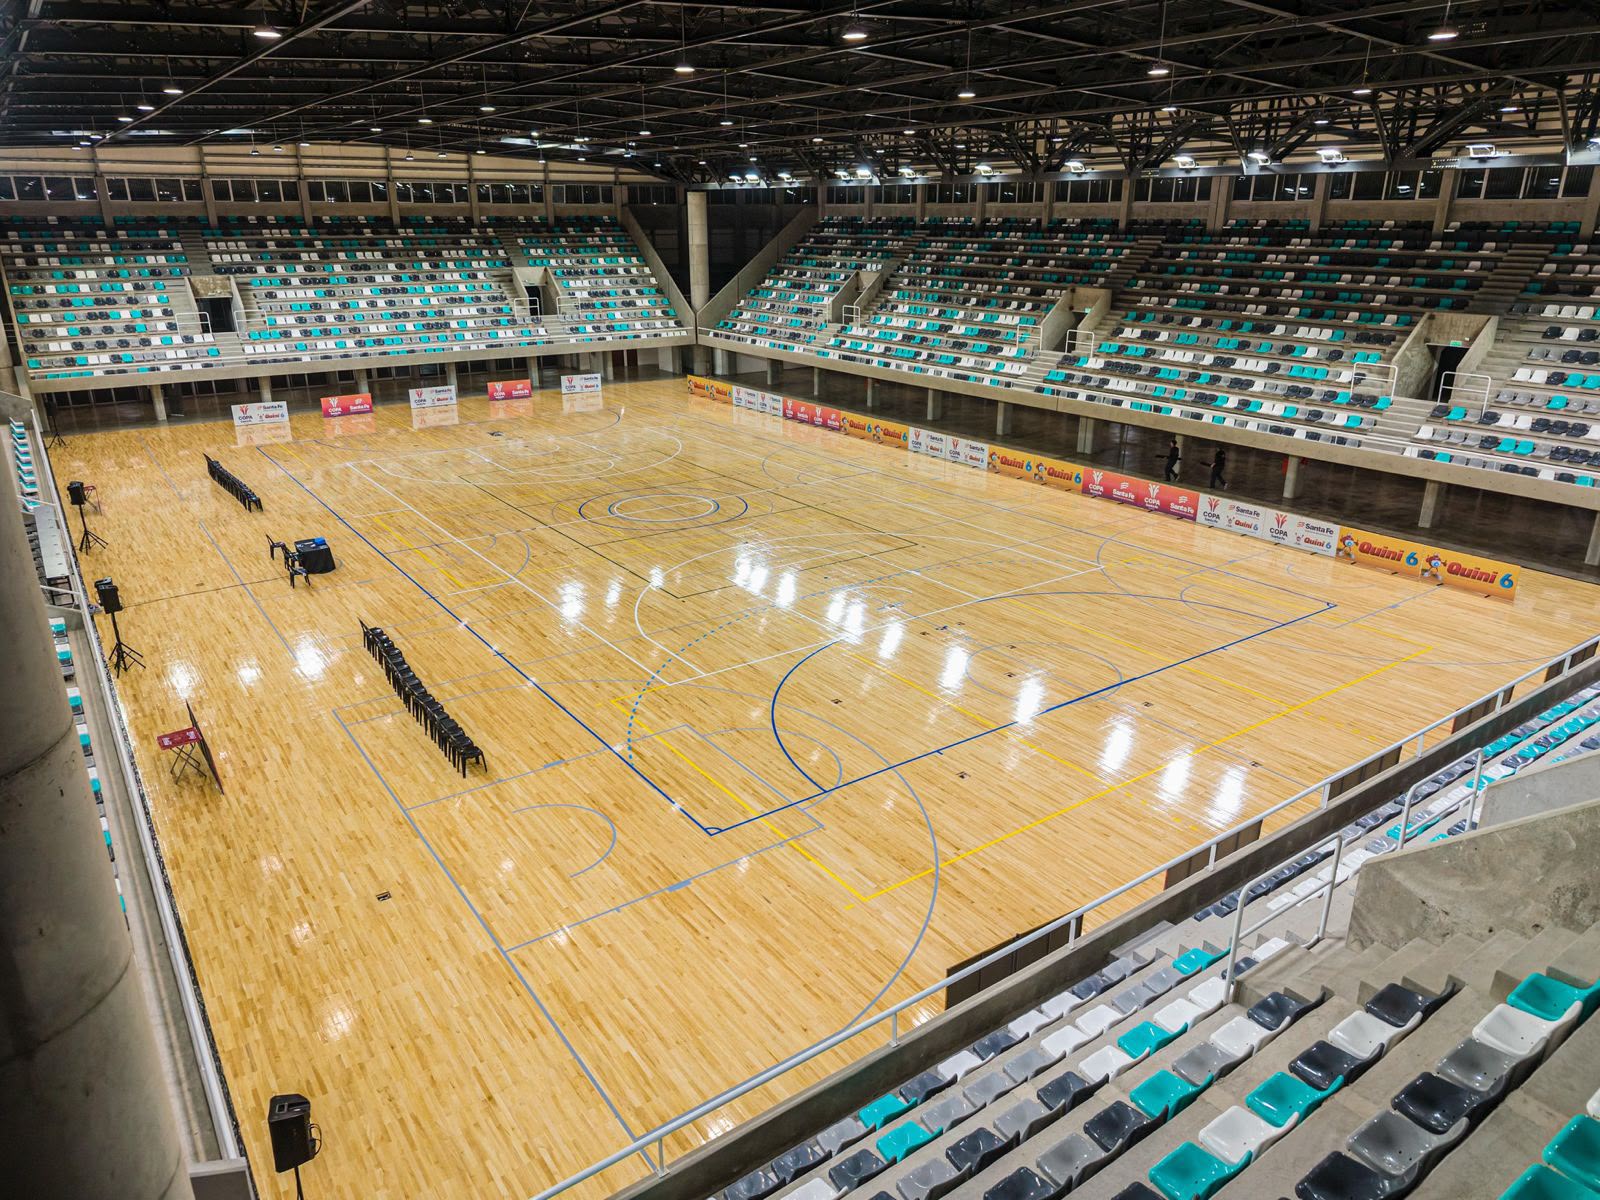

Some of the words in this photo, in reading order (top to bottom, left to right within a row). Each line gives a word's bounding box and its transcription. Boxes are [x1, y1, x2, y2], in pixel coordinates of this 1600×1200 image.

[867, 424, 872, 433] 6
[1000, 455, 1024, 469] Quini
[1026, 461, 1032, 472] 6
[1047, 467, 1073, 480] Quini
[1074, 472, 1082, 484] 6
[1089, 484, 1103, 492] COPA
[1113, 488, 1128, 498] Santa
[1170, 502, 1186, 512] Santa
[1236, 506, 1252, 515] Santa
[1203, 511, 1220, 519] COPA
[1235, 520, 1252, 529] Quini
[1305, 523, 1325, 533] Santa
[1270, 528, 1288, 537] COPA
[1304, 537, 1325, 547] Quini
[1358, 541, 1404, 562] Quini
[1406, 552, 1418, 566] 6
[1447, 561, 1498, 583] Quini
[1499, 573, 1513, 589] 6
